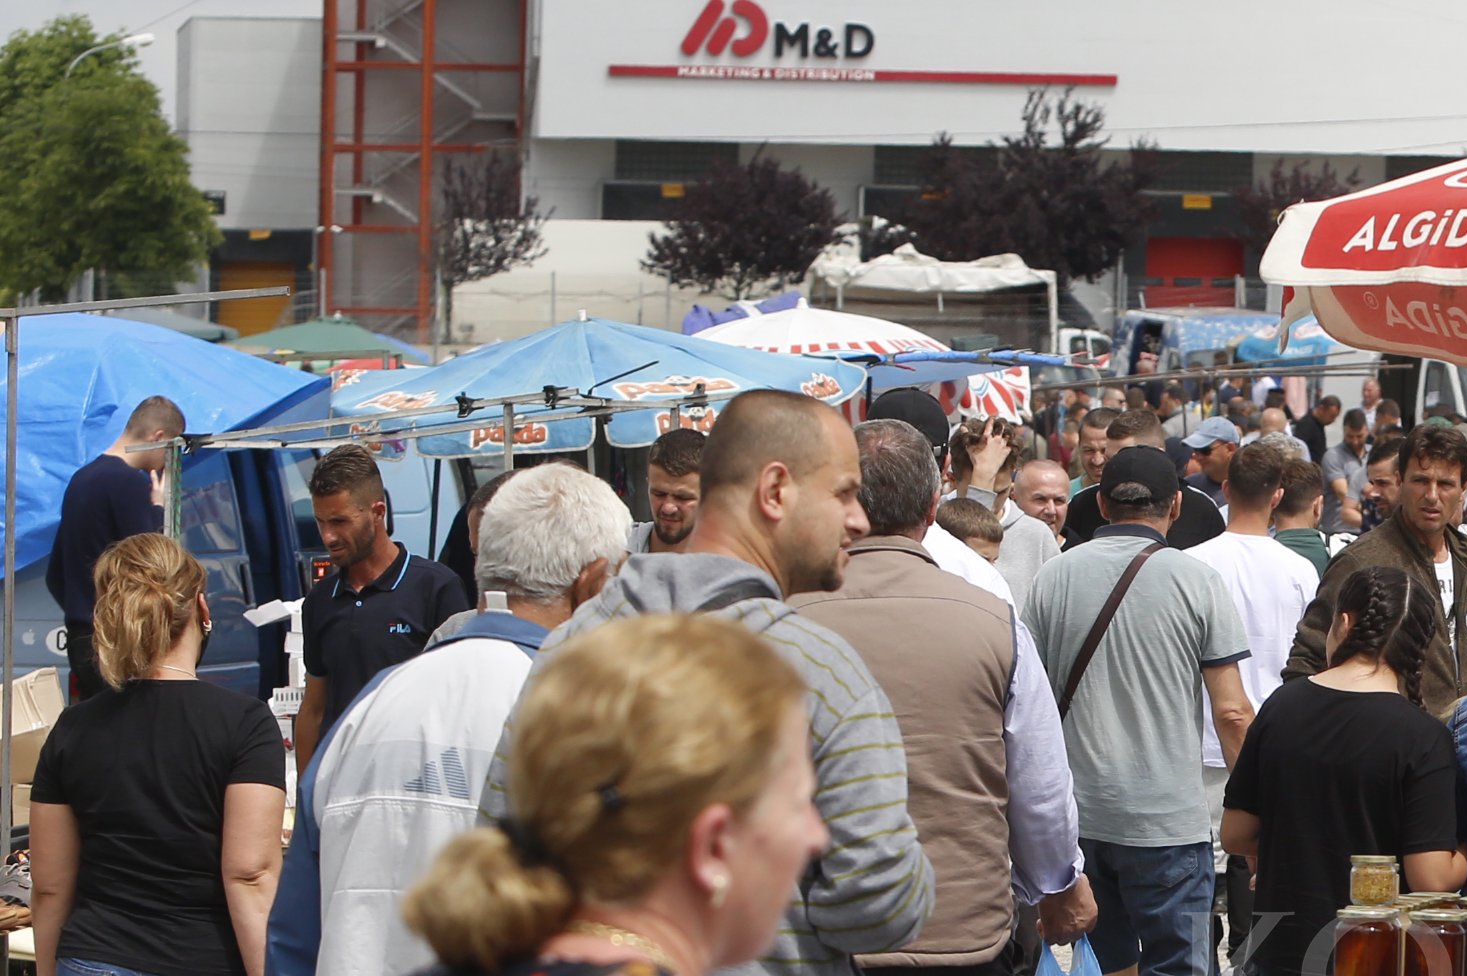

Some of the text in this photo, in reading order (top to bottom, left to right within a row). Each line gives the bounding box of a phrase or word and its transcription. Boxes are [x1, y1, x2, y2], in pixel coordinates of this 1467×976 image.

[774, 22, 875, 58] M&D
[678, 66, 760, 79] MARKETING
[774, 68, 876, 81] DISTRIBUTION
[388, 623, 411, 633] FILA
